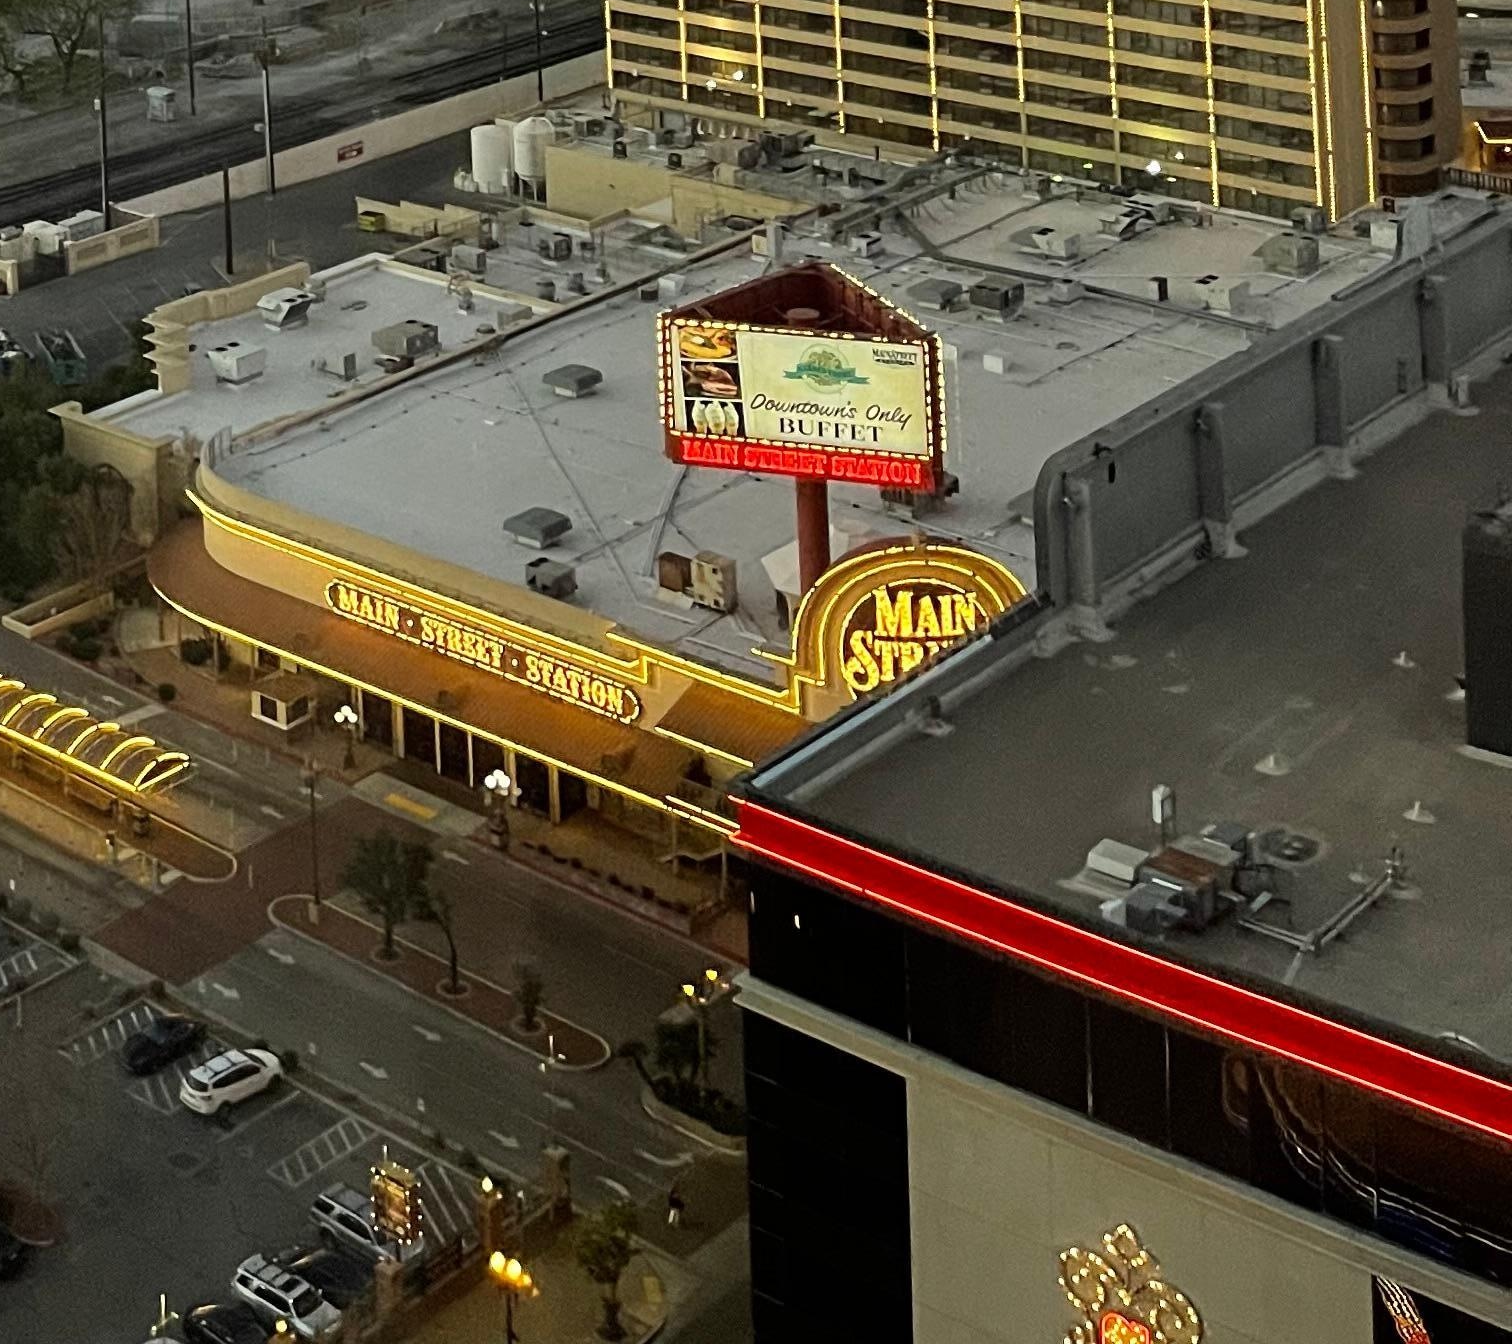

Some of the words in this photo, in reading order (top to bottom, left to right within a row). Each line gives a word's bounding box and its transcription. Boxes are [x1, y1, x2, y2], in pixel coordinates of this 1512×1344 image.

[750, 393, 857, 418] Downtown's
[866, 403, 913, 431] Only
[779, 417, 883, 443] BUFFET
[681, 439, 739, 465] MAIN
[744, 445, 827, 475] STREET
[831, 455, 921, 485] STATION
[873, 588, 976, 638] MAIN
[337, 585, 400, 630] MAIN
[419, 615, 505, 667] STREET
[525, 655, 623, 714] STATION
